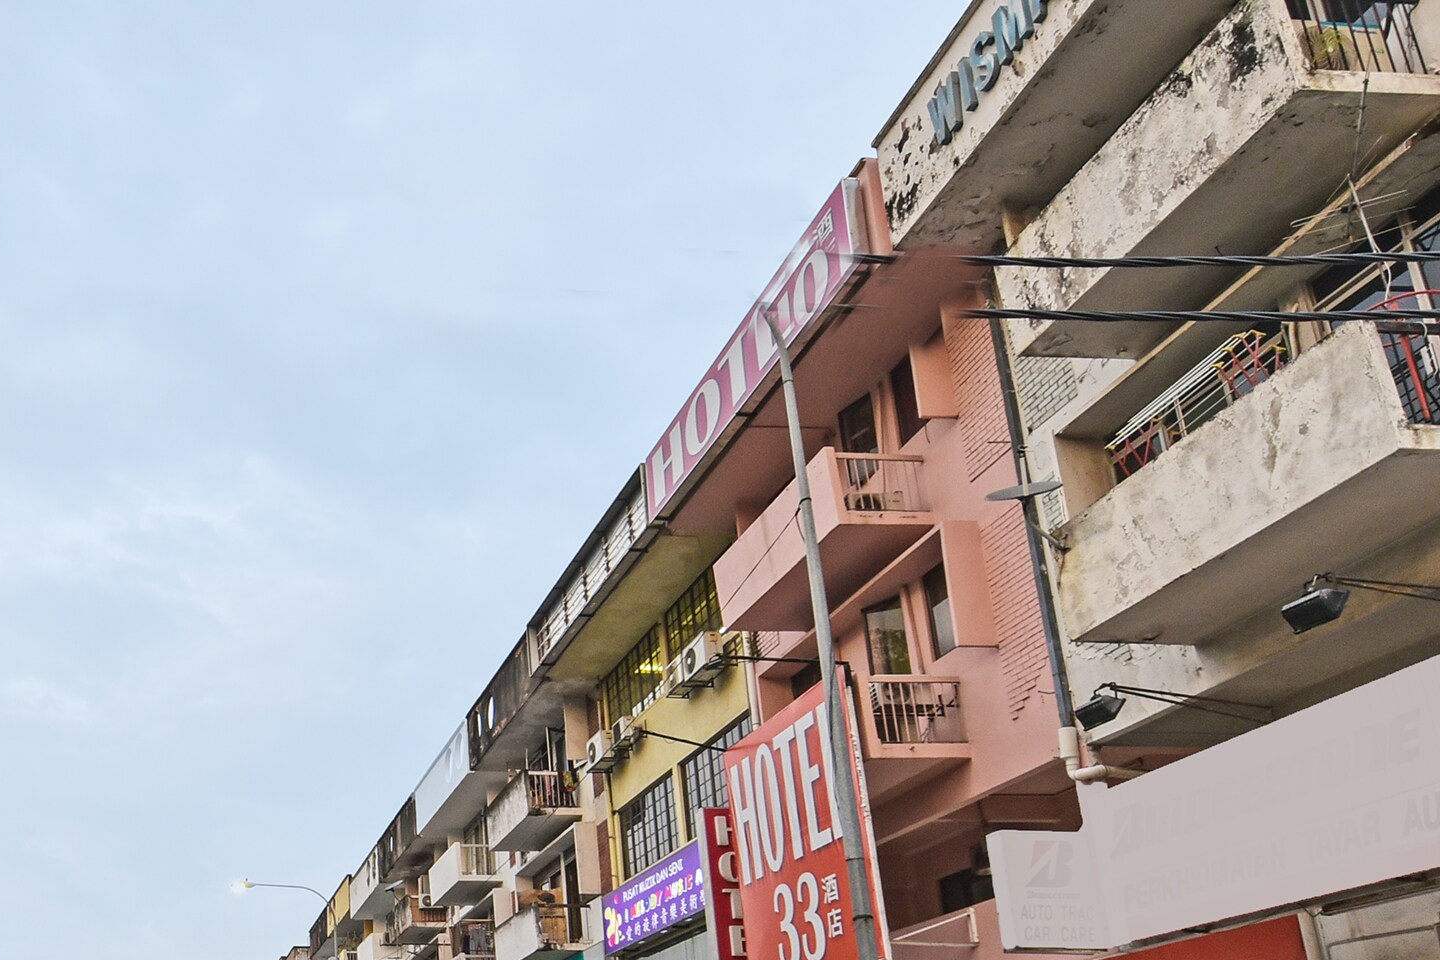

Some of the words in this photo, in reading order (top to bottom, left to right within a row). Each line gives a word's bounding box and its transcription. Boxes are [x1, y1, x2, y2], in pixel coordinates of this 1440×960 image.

[927, 0, 1048, 145] WISM
[821, 872, 844, 939] 酒店
[1020, 904, 1053, 921] AUTO
[1024, 926, 1051, 942] CAR
[1061, 926, 1096, 942] CARE
